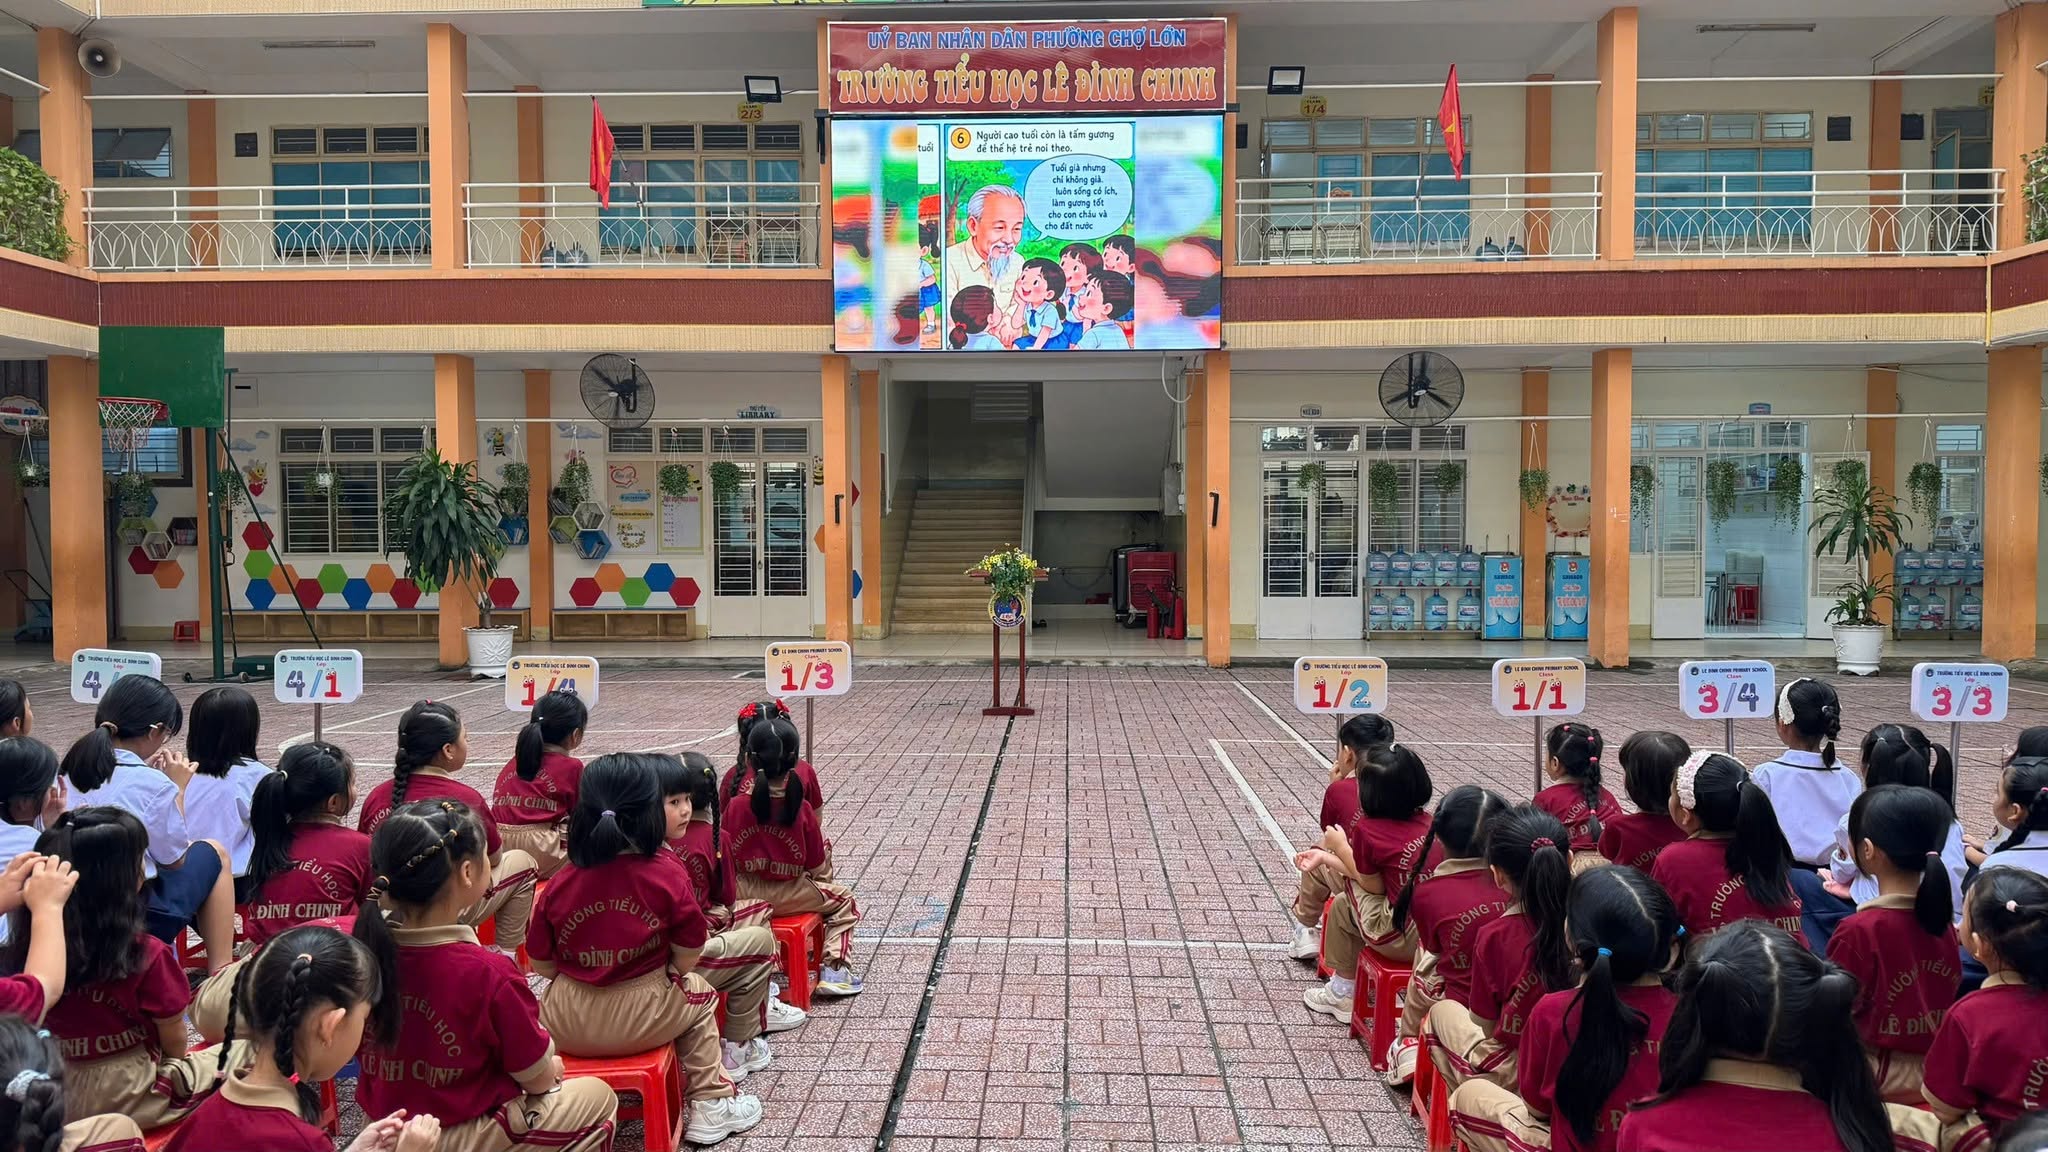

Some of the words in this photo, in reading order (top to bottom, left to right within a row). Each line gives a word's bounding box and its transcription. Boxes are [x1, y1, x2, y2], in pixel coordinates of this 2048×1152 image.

[867, 25, 892, 50] UỶ
[895, 31, 932, 50] BAN
[937, 26, 985, 50] NHÂN
[991, 26, 1027, 49] DÂN
[1032, 25, 1105, 49] PHƯỜNG
[1108, 26, 1147, 51] CHỢ
[1150, 24, 1187, 47] LỚN
[836, 62, 929, 104] TRƯỜNG
[933, 52, 986, 104] TIỂU
[989, 68, 1038, 110] HỌC
[1042, 60, 1070, 103] LÊ
[1074, 60, 1135, 101] ĐÌNH
[1140, 66, 1217, 101] CHINH
[740, 109, 762, 119] 2/3
[1303, 104, 1327, 114] 1/4
[957, 132, 965, 144] 6
[976, 130, 1002, 142] Người
[1003, 132, 1019, 140] cao
[1021, 128, 1038, 139] tuổi
[1040, 130, 1056, 139] còn
[1058, 129, 1066, 139] là
[1069, 128, 1086, 139] tấm
[1088, 131, 1115, 141] gương
[917, 141, 934, 152] tuổi
[976, 142, 988, 153] để
[989, 142, 1005, 153] thế
[1006, 143, 1017, 154] hệ
[1020, 143, 1033, 153] trẻ
[1051, 143, 1073, 152] theo.
[1050, 162, 1067, 172] Tuổi
[1069, 163, 1080, 174] già
[1082, 163, 1106, 174] nhưng
[1065, 175, 1088, 185] không
[1055, 187, 1072, 195] luôn
[1073, 186, 1091, 197] sống
[1093, 187, 1102, 195] có
[1052, 198, 1066, 207] làm
[1067, 200, 1091, 209] gương
[1093, 197, 1104, 207] tốt
[1048, 210, 1062, 219] cho
[1078, 210, 1097, 219] cháu
[1098, 210, 1108, 218] và
[1044, 221, 1058, 230] cho
[1060, 221, 1073, 230] đất
[1075, 221, 1094, 230] nước
[740, 411, 775, 419] LIBRARY
[285, 669, 342, 698] 4/1
[780, 661, 834, 691] 1/3
[1312, 678, 1372, 709] 1/2
[1512, 679, 1567, 711] 1/1
[1697, 682, 1760, 714] 3/4
[1931, 684, 1993, 716] 3/3
[524, 796, 558, 812] CHINH
[769, 861, 803, 877] CHINH
[321, 872, 340, 899] HỌC
[256, 900, 291, 920] ĐÌNH
[294, 903, 343, 918] CHINH
[558, 901, 606, 946] TRƯỜNG
[608, 895, 641, 915] TIỂU
[1449, 902, 1490, 949] TRƯỜNG
[578, 945, 614, 968] ĐÌNH
[1921, 957, 1952, 977] TIỂU
[1502, 1013, 1523, 1036] LÊ
[1878, 1013, 1900, 1036] LÊ
[434, 1018, 462, 1057] HỌC
